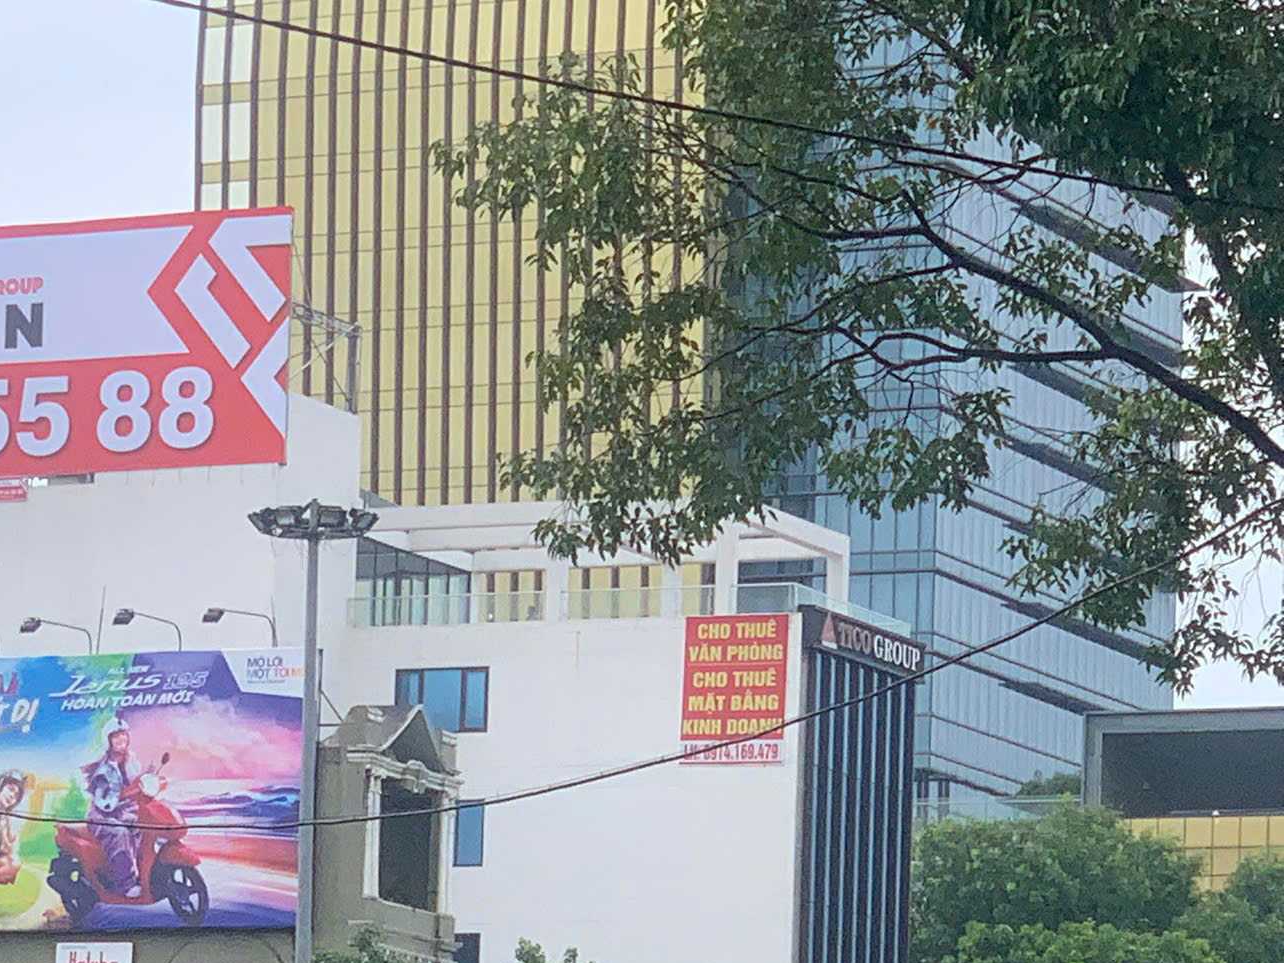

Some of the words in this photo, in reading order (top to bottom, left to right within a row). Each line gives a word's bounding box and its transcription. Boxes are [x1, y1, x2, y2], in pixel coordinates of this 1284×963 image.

[96, 367, 214, 450] 88
[698, 623, 730, 640] CHO
[736, 618, 777, 639] THUÊ
[689, 644, 722, 662] VĂN
[727, 643, 783, 661] PHÒNG
[873, 634, 921, 671] GROUP
[693, 671, 727, 688] CHO
[733, 668, 777, 687] THUÊ
[688, 693, 726, 714] MẶT
[682, 719, 721, 735] KINH
[727, 718, 784, 735] DOANH
